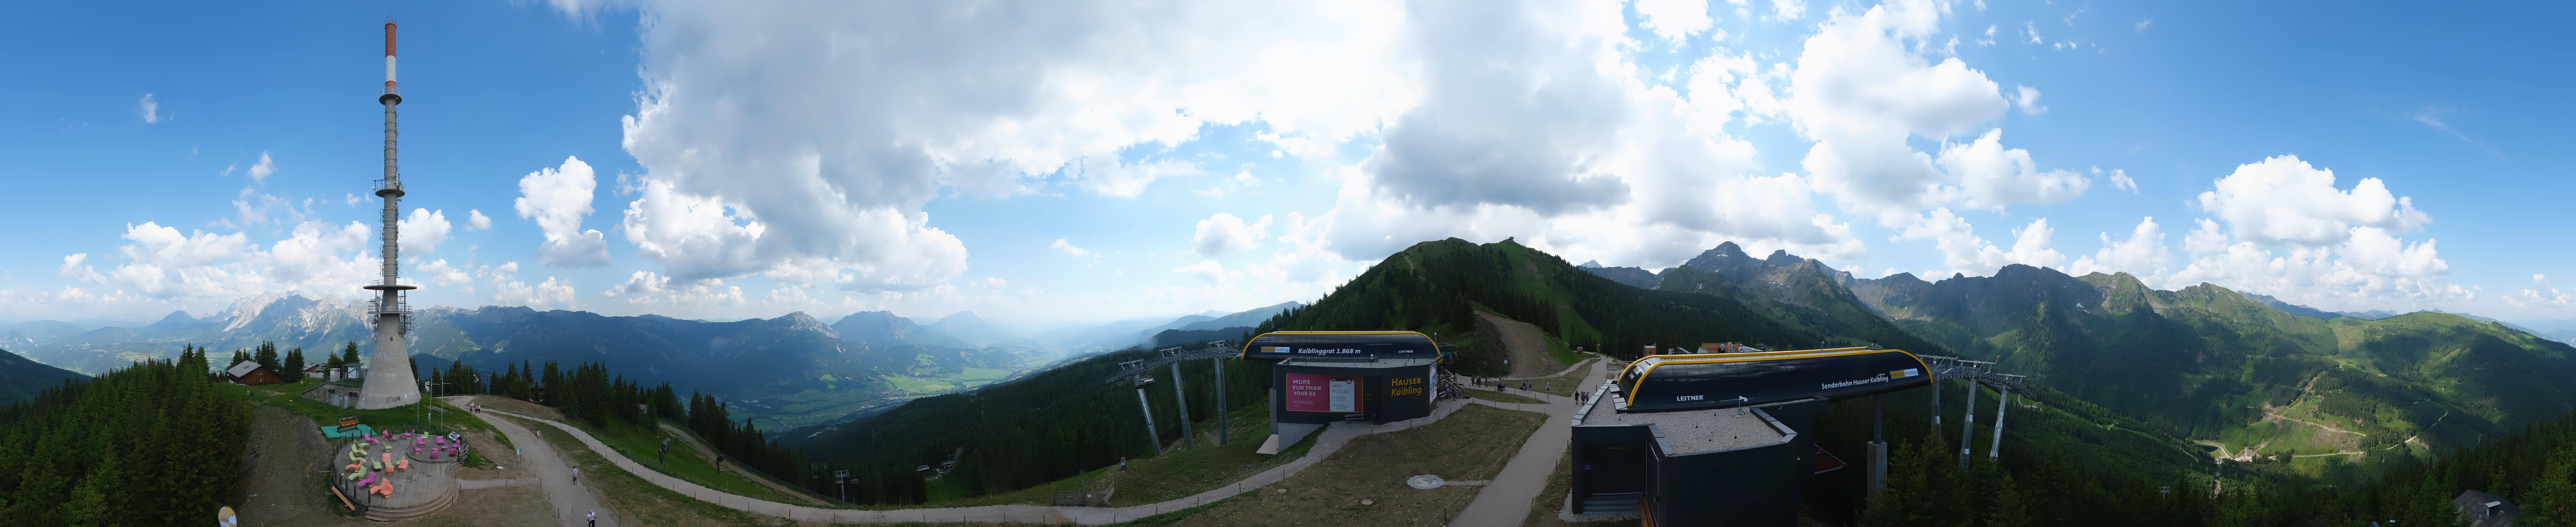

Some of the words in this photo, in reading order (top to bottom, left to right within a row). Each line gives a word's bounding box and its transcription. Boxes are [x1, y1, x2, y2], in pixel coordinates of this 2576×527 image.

[1392, 378, 1421, 386] HAUSER
[1822, 380, 1852, 389] Senderbahn
[1391, 387, 1422, 396] Kaibling
